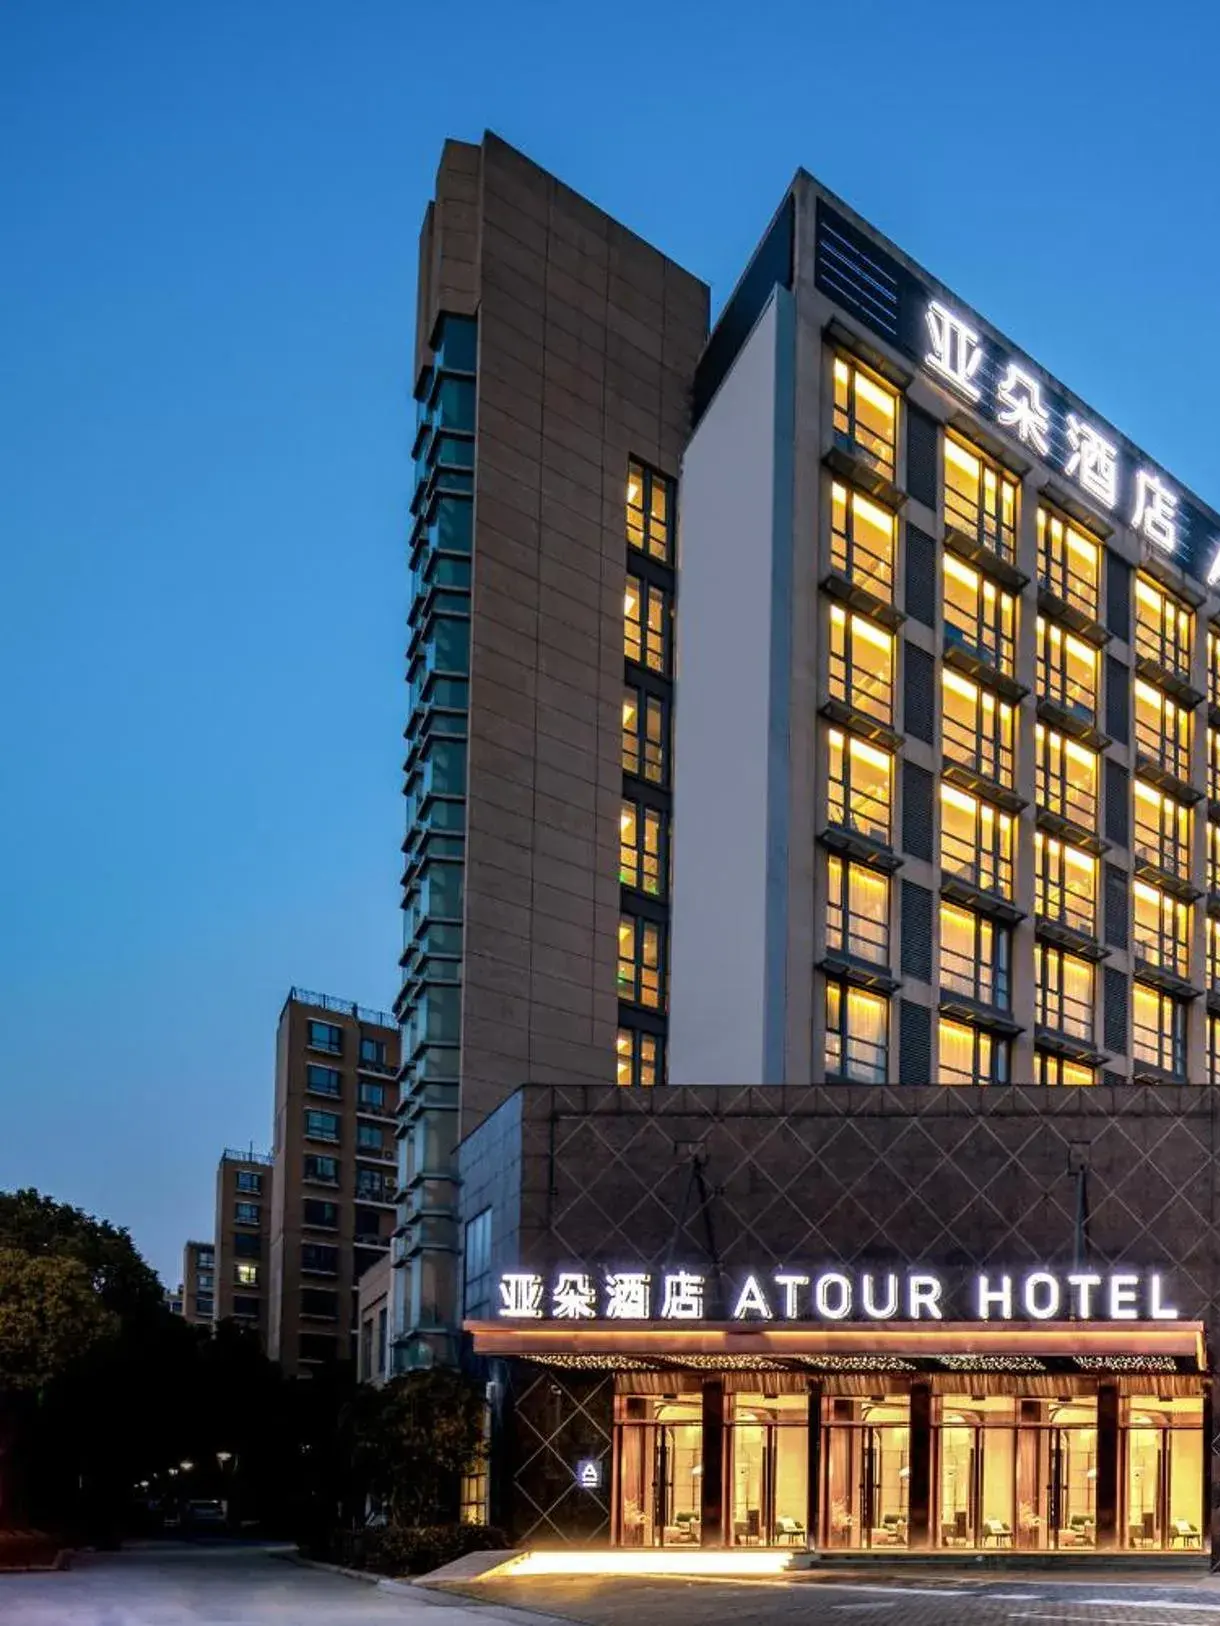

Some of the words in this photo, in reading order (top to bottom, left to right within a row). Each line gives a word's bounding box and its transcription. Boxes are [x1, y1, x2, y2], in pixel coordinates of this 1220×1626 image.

[924, 300, 1179, 553] 亚朵酒店
[498, 1271, 706, 1320] 亚朵酒店
[734, 1273, 943, 1320] ATOUR
[978, 1272, 1180, 1320] HOTEL
